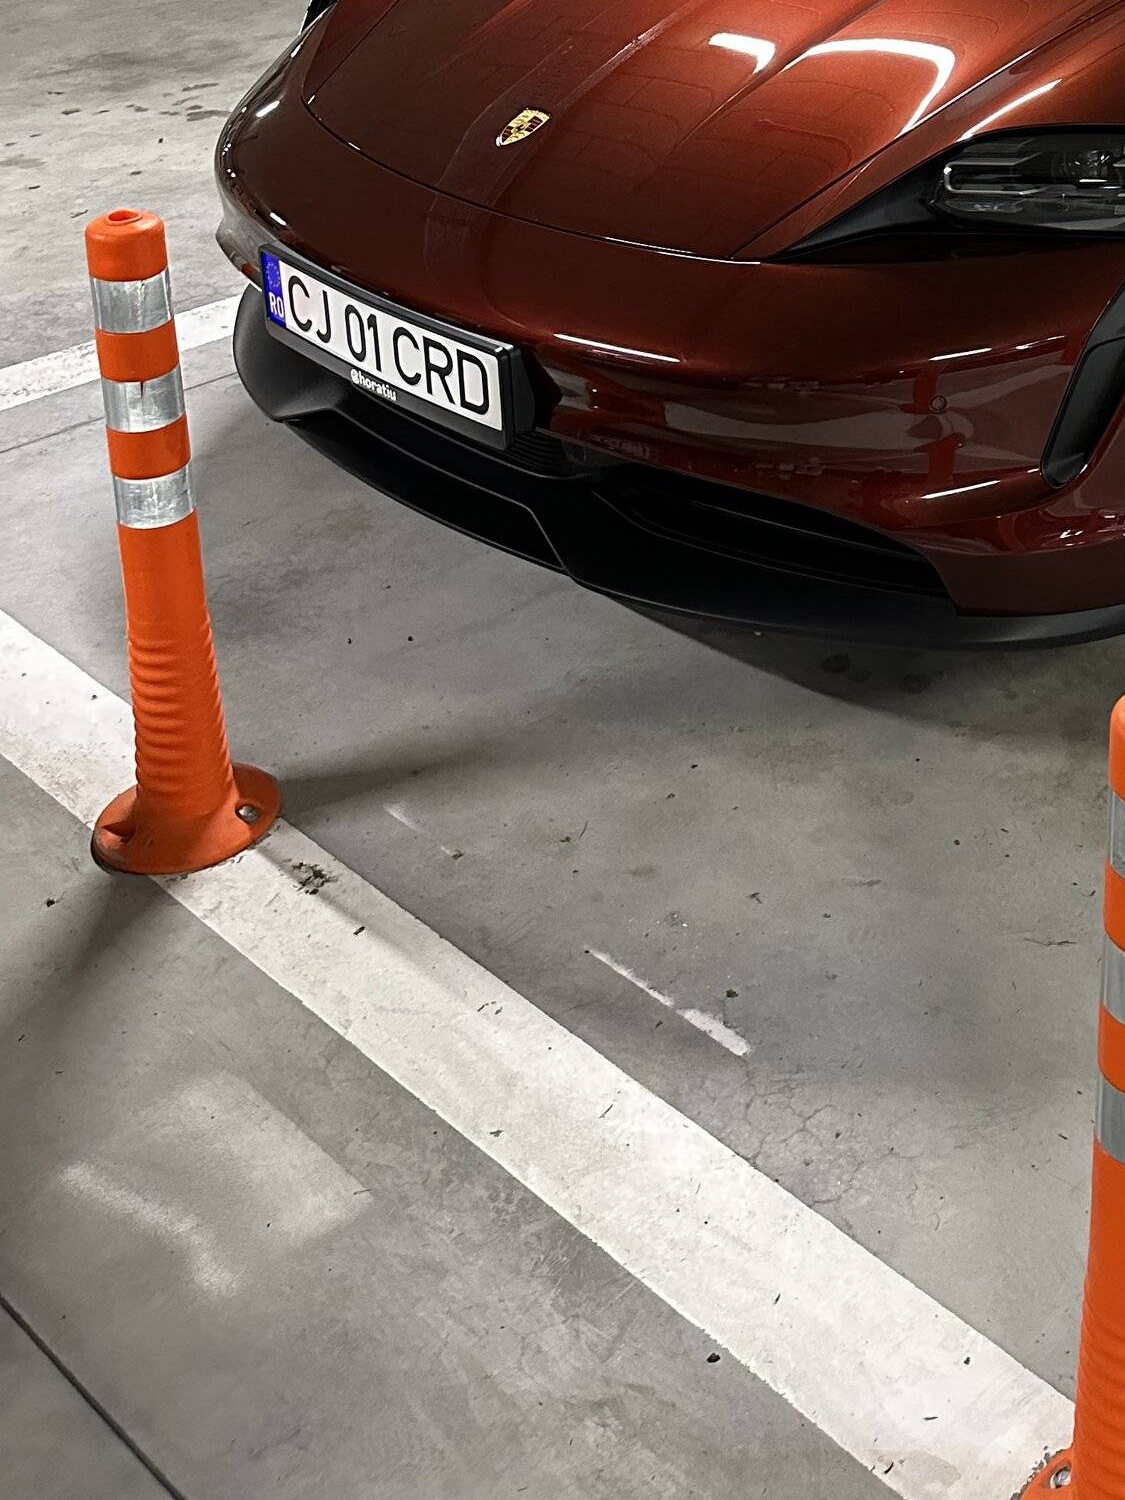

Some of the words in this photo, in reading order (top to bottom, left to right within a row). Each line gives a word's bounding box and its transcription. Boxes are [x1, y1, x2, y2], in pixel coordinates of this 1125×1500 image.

[269, 291, 285, 318] RO
[288, 275, 332, 344] CJ
[345, 304, 382, 372] 01
[392, 327, 490, 416] CRD
